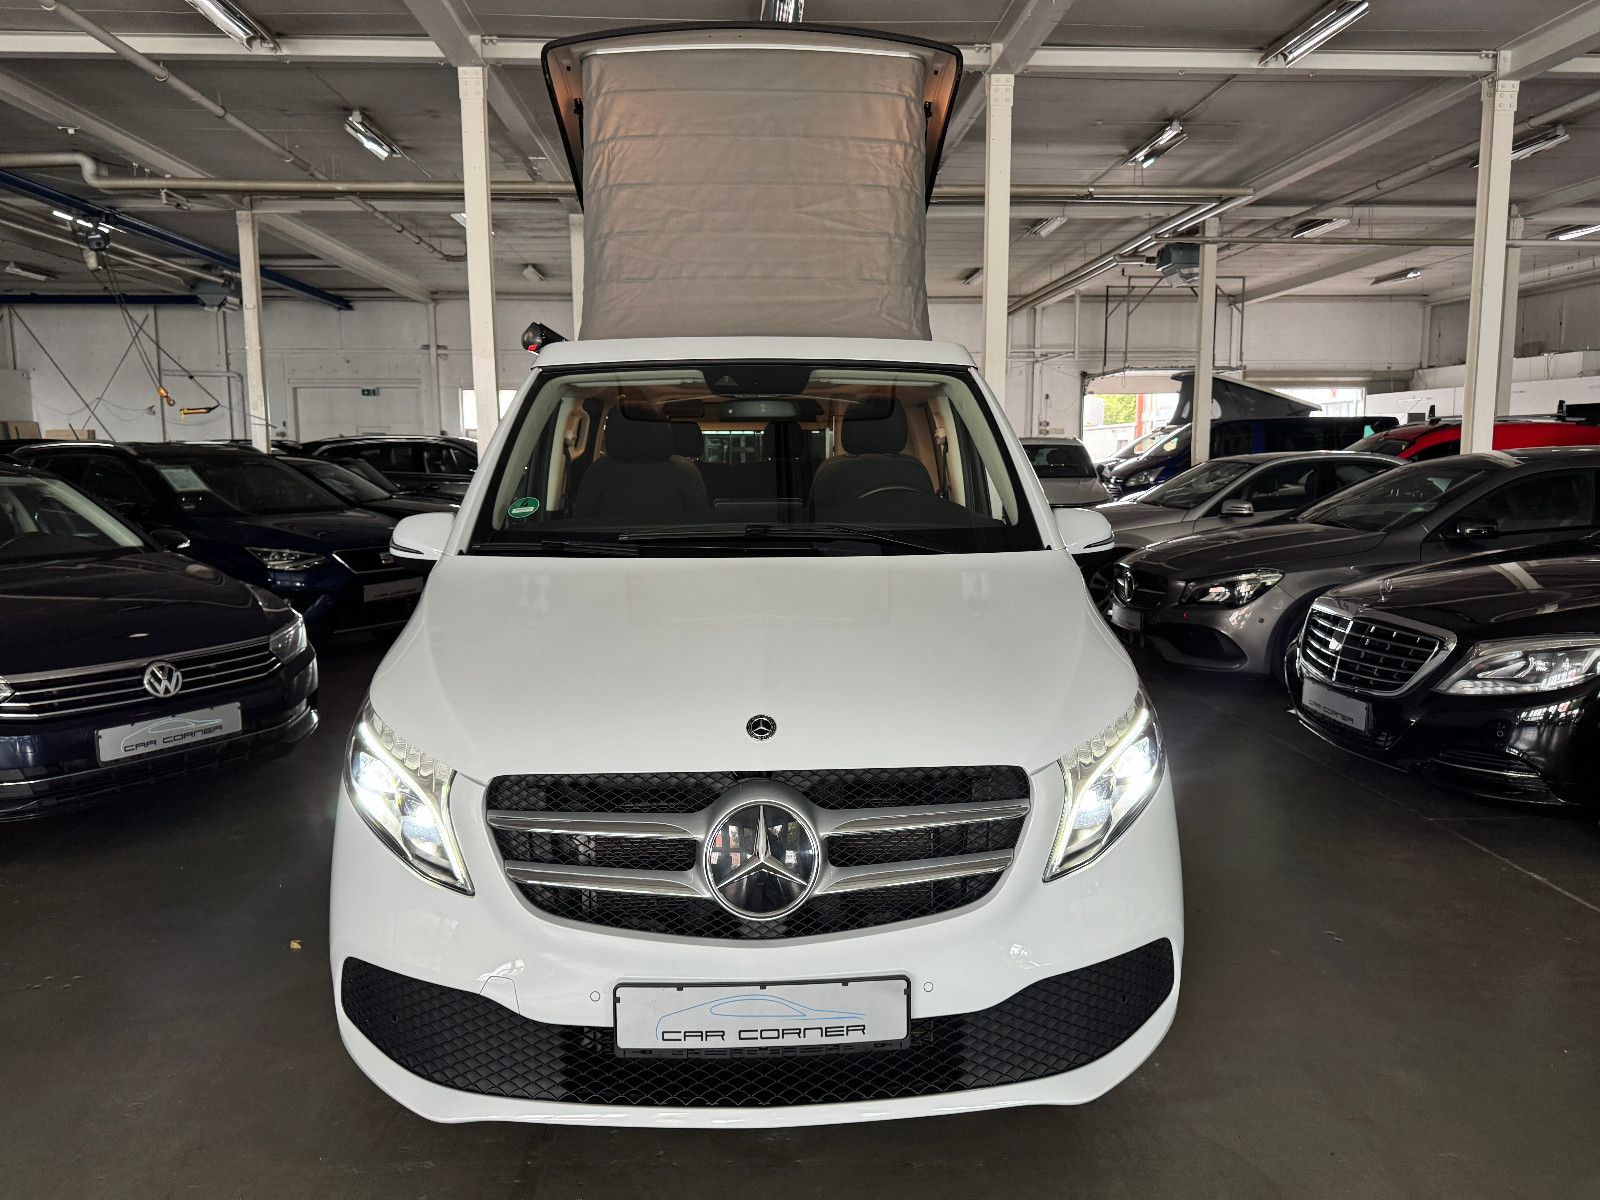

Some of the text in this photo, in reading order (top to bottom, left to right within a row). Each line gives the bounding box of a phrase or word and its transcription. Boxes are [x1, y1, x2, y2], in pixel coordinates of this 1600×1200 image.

[520, 498, 529, 507] 4
[124, 724, 223, 752] CAR CORNER
[661, 1024, 866, 1042] CAR CORNER
